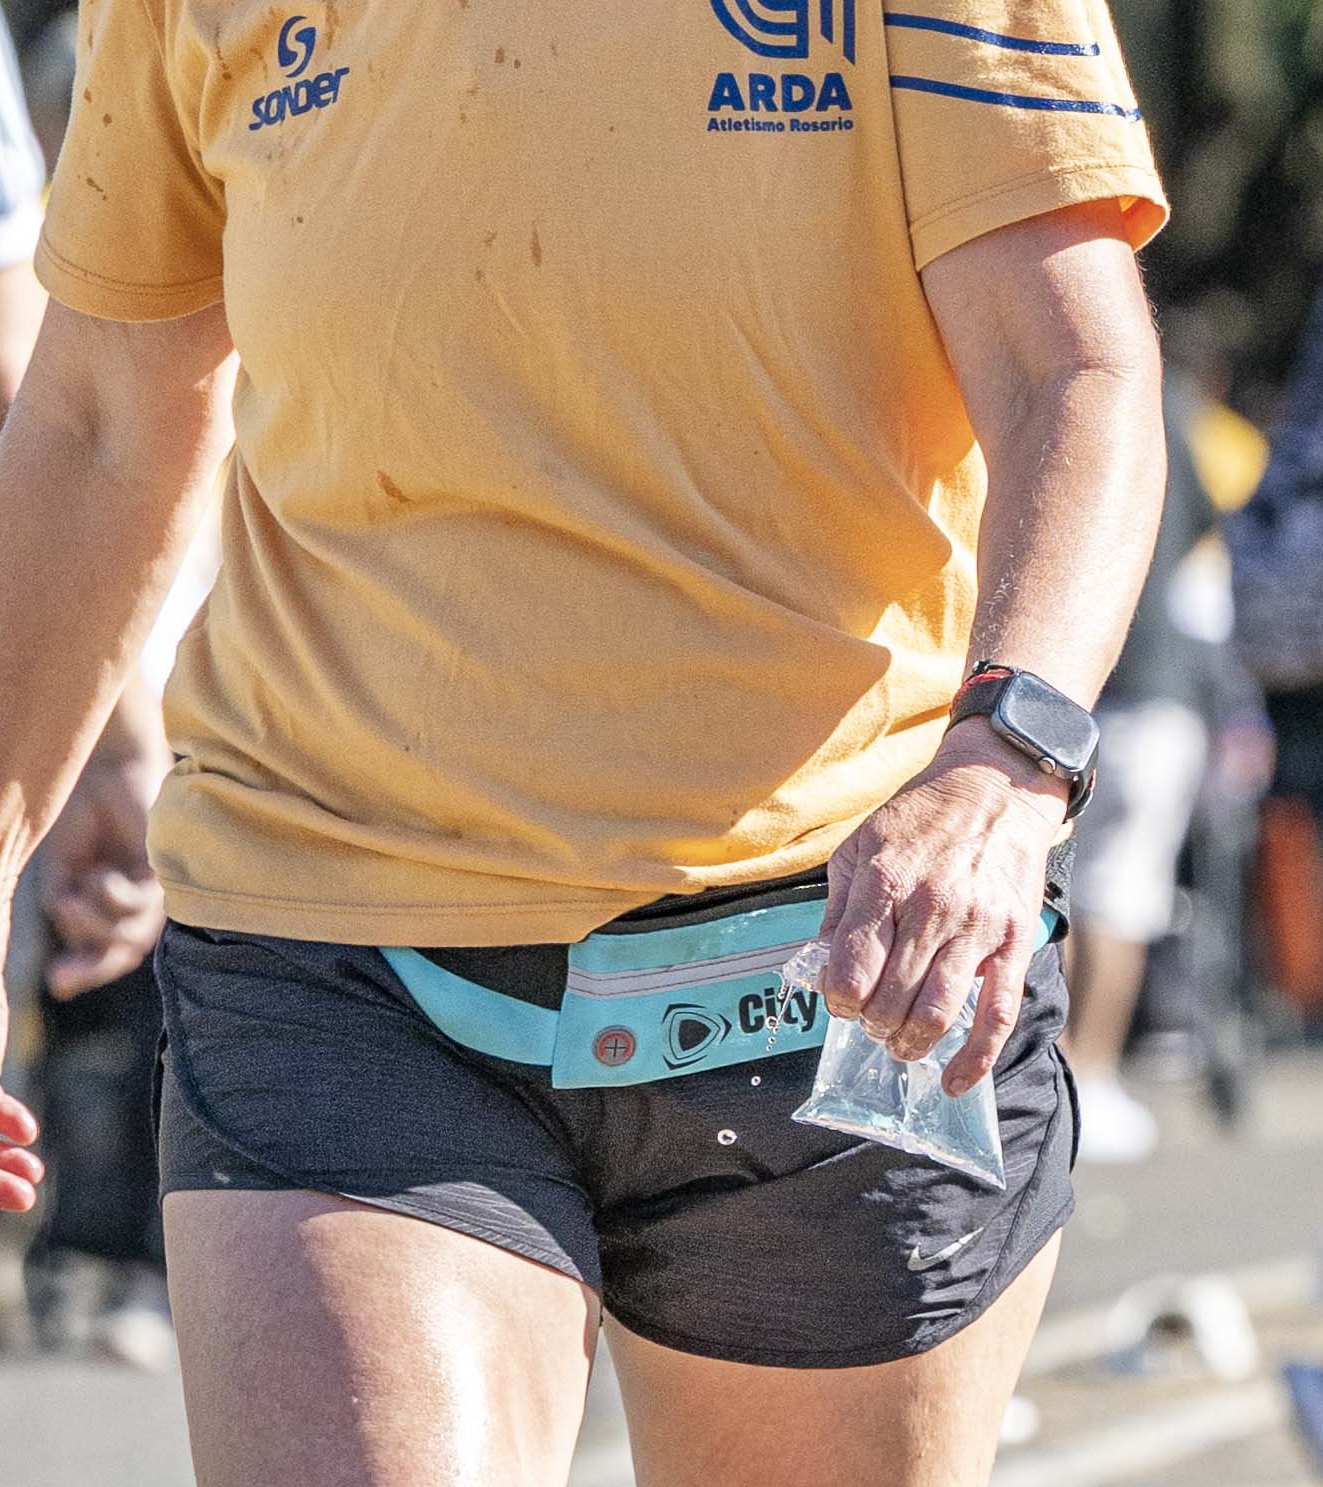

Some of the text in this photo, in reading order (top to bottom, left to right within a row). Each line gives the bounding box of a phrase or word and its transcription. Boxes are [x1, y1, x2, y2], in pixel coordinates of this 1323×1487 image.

[706, 72, 854, 113] ARDA
[706, 116, 855, 133] Atletismo Rosario
[738, 985, 819, 1034] City
